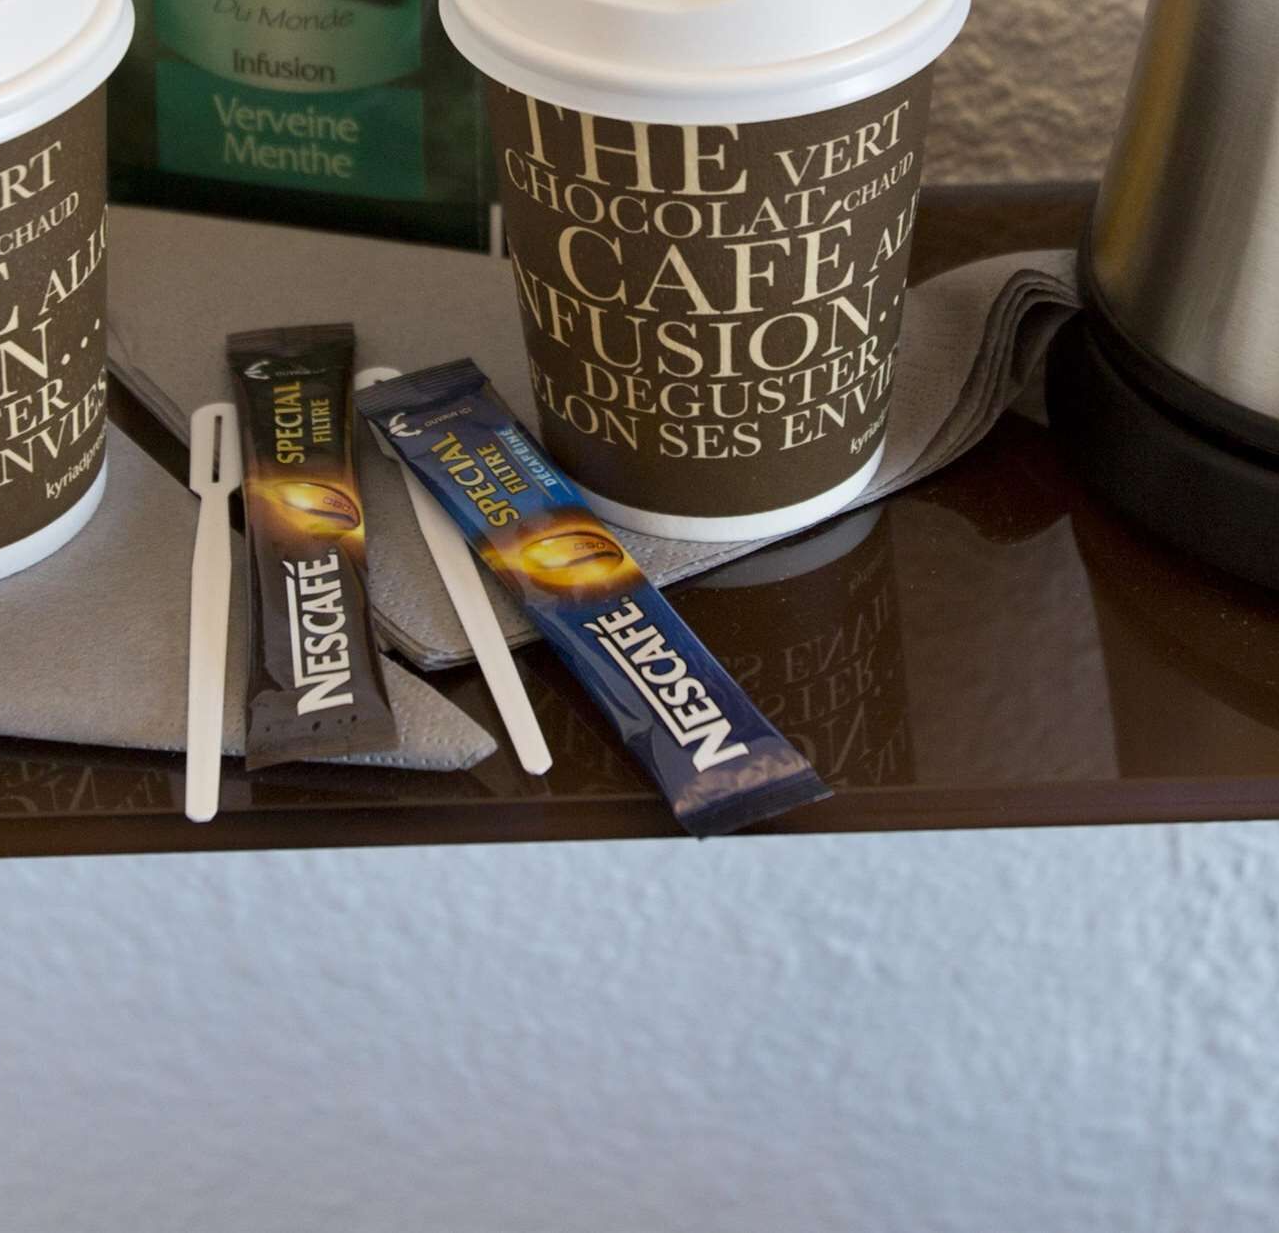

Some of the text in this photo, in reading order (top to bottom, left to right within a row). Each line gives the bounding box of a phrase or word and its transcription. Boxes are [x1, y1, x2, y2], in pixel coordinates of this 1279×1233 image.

[258, 4, 356, 32] Monde
[232, 49, 337, 85] Infusion
[213, 93, 360, 144] Verveine
[223, 132, 354, 179] Menthe
[773, 100, 910, 187] VERT
[504, 146, 915, 240] CHOCOLAT CHAUD
[557, 198, 855, 317] CAFÉ
[580, 334, 883, 419] DÉGUSTER
[273, 380, 306, 465] SPECIAL
[310, 397, 333, 445] FILTRE
[659, 422, 763, 459] SES
[430, 431, 520, 528] SPECIAL
[475, 442, 530, 496] FILTRE
[282, 552, 355, 717] NESCAFÉ
[583, 599, 753, 774] NESCAFÉ
